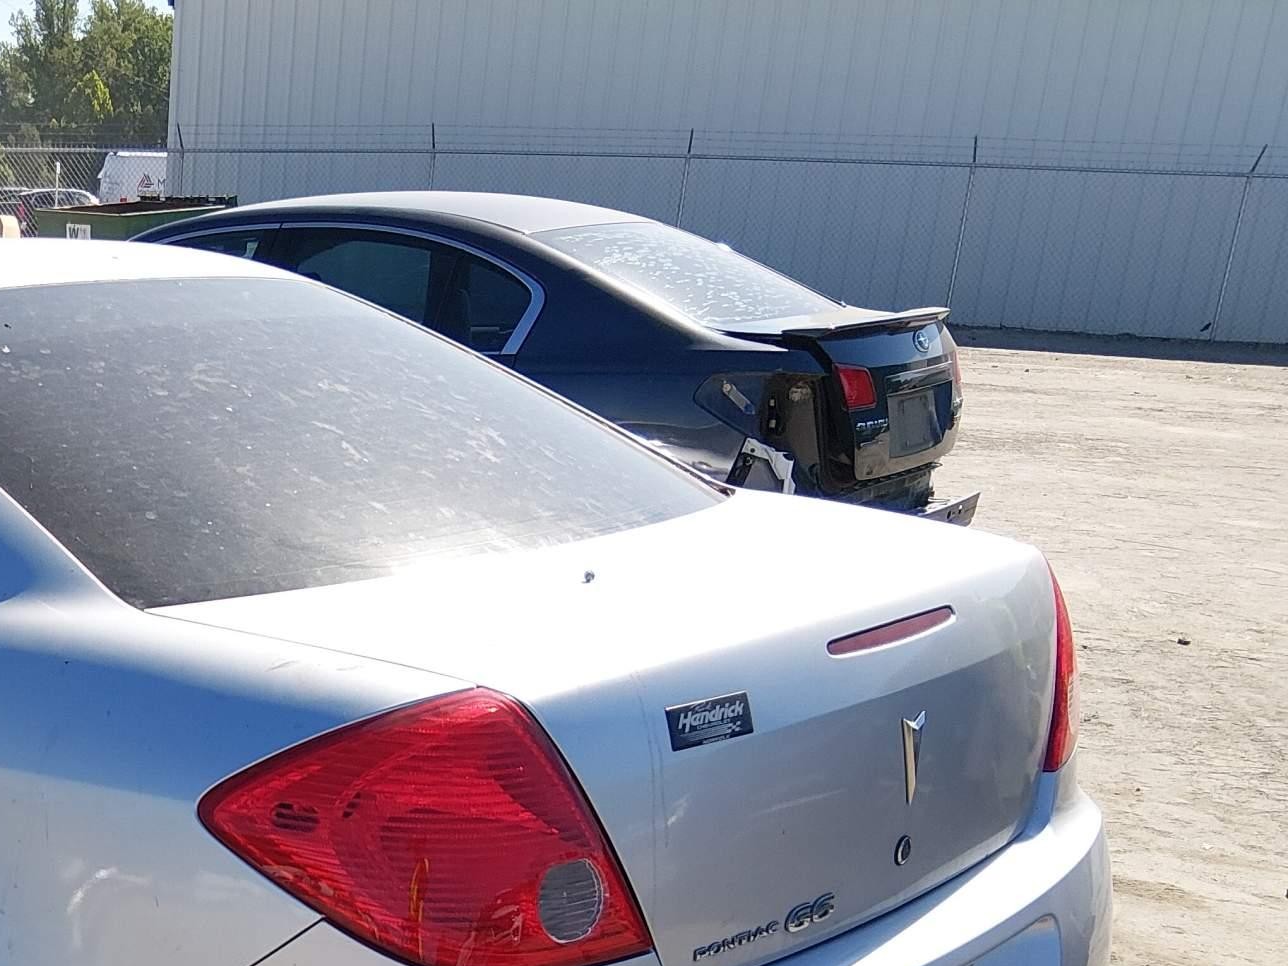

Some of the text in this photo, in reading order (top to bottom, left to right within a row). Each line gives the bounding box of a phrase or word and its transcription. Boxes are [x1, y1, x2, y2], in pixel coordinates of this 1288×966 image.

[678, 700, 745, 733] Hendrick
[693, 892, 835, 961] PONTIAC G6
